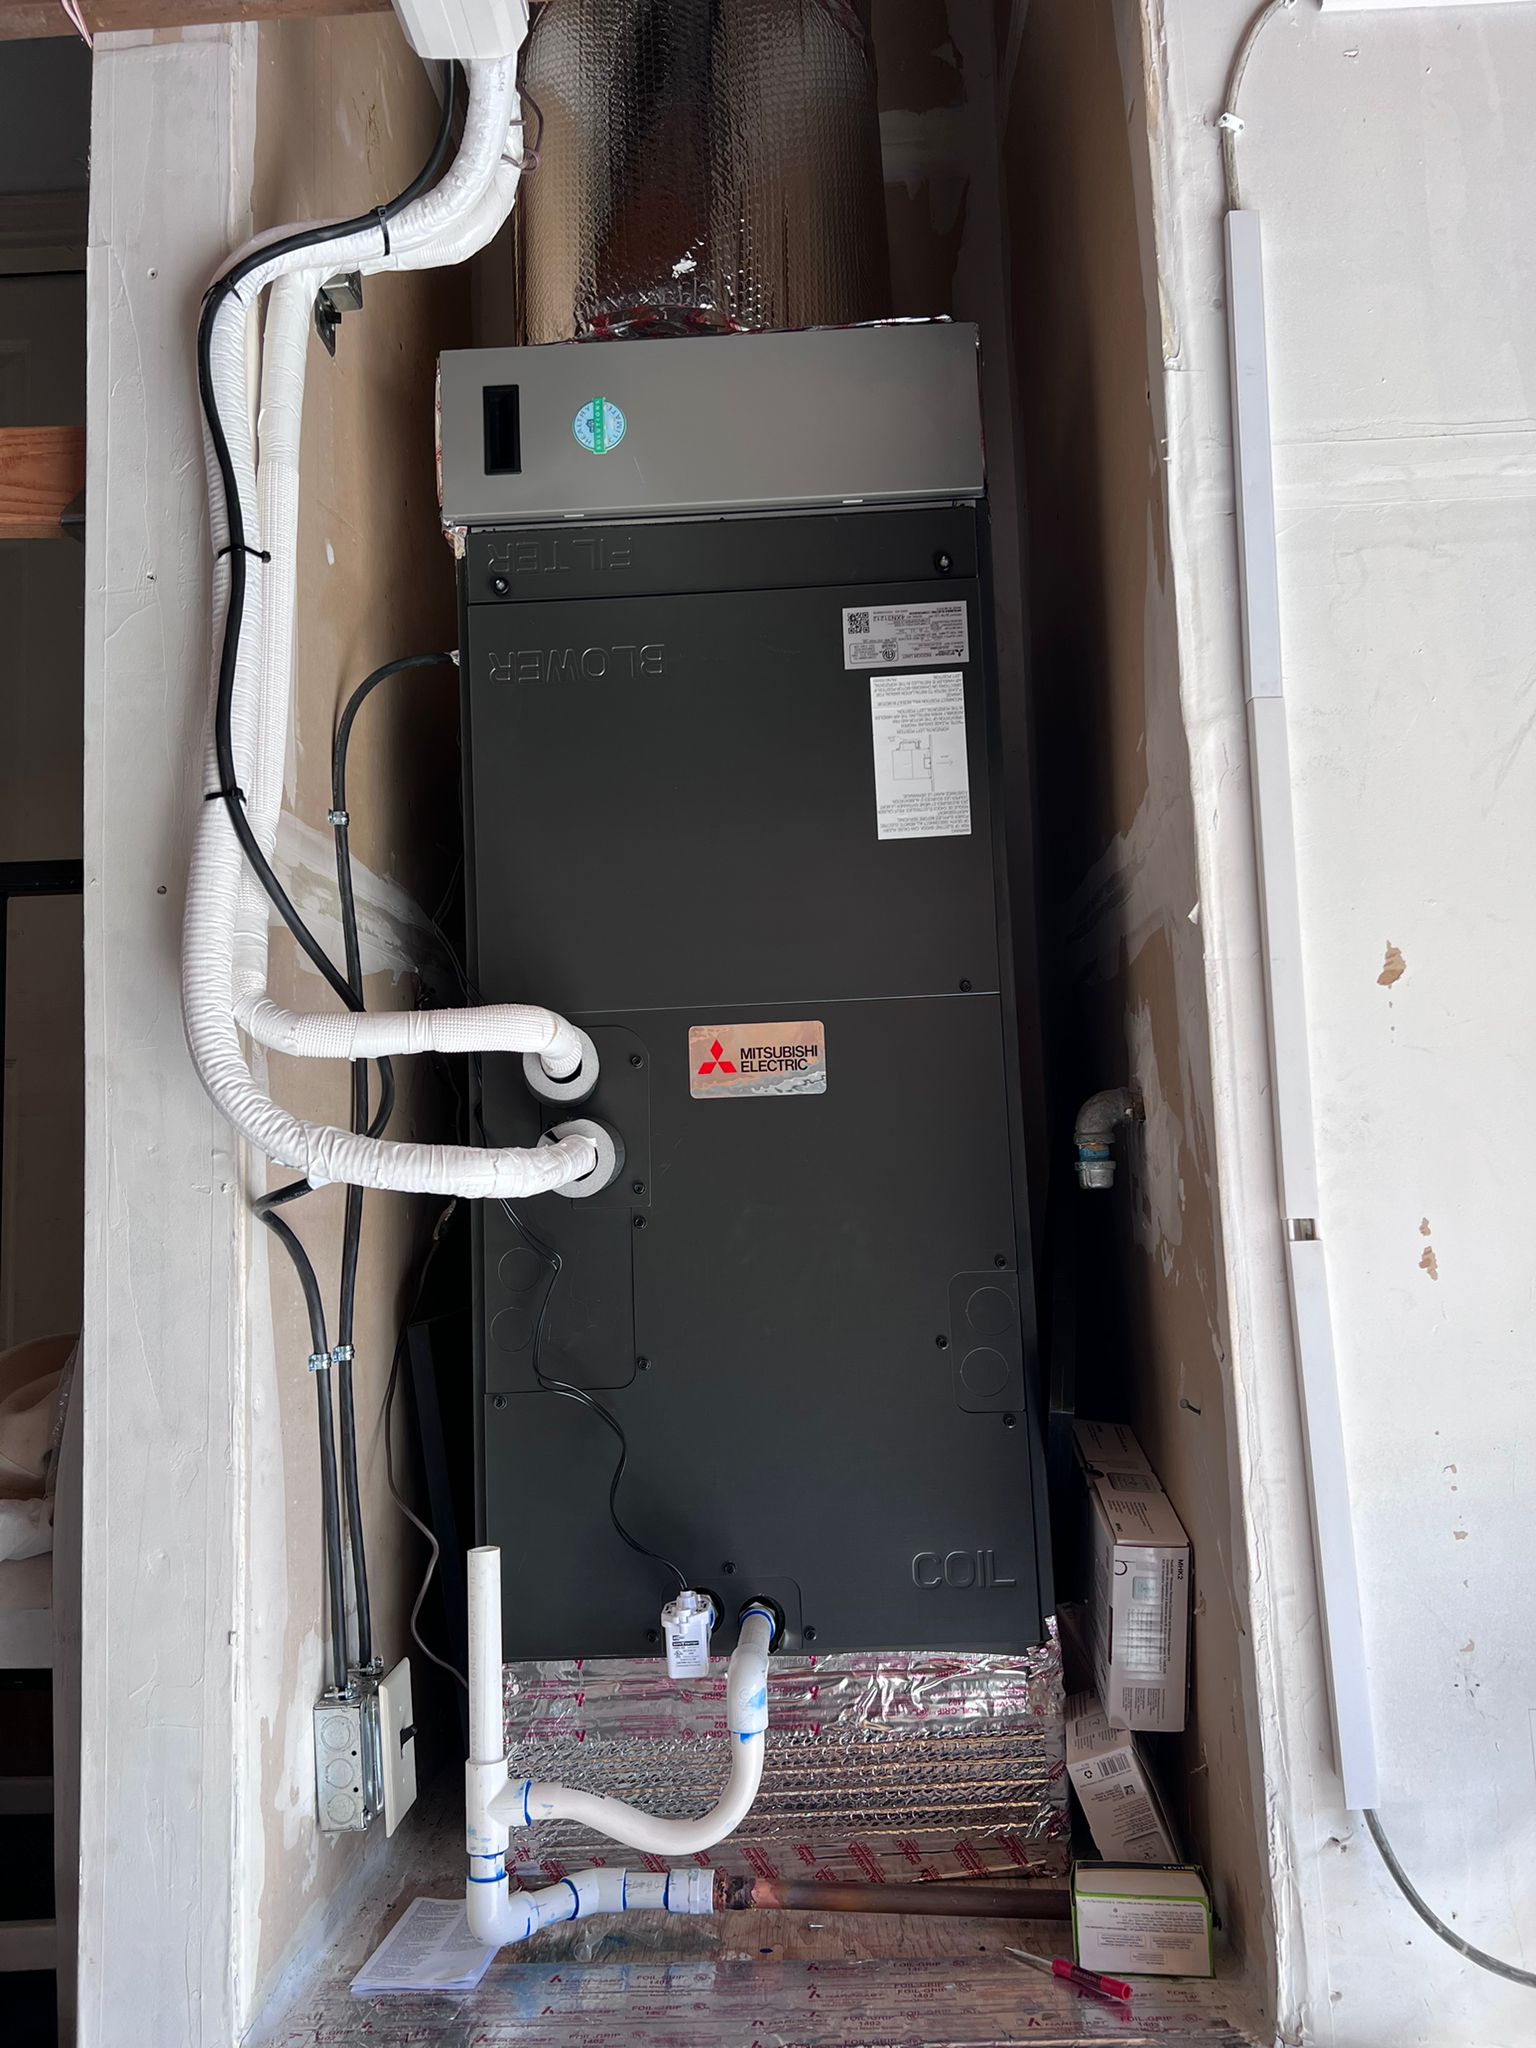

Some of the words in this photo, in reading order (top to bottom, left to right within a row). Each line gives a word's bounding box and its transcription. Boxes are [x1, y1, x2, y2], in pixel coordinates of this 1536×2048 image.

[576, 404, 591, 446] HEALTHY
[607, 404, 624, 445] CLIMATE
[488, 536, 633, 574] FILTER
[489, 643, 666, 684] BLOWER
[740, 1045, 818, 1060] MITSUBISHI
[740, 1058, 808, 1073] ELECTRIC
[911, 1549, 1016, 1588] COIL
